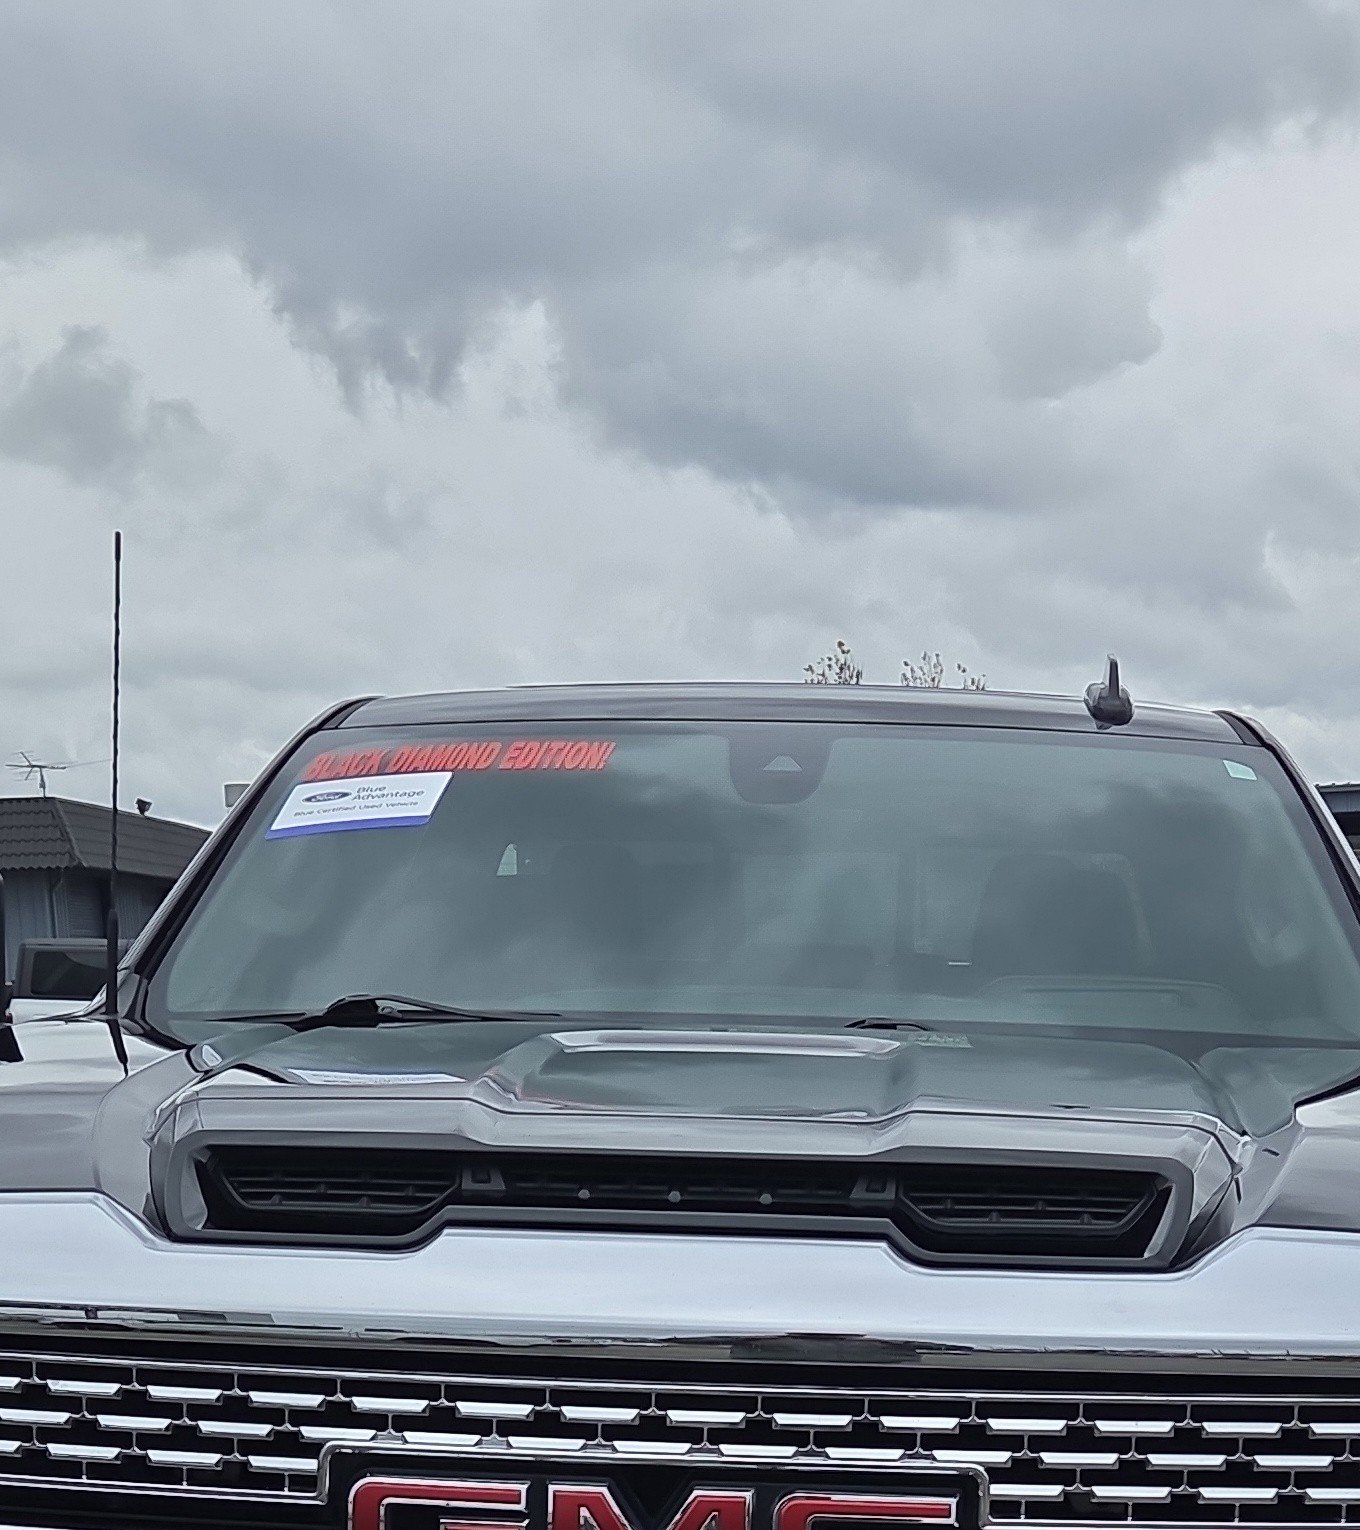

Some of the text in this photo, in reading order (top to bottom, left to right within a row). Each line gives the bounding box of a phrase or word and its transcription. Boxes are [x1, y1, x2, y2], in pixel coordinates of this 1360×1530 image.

[304, 741, 616, 780] BLACK DIAMOND EDITION!
[356, 786, 387, 794] Blue
[351, 790, 426, 801] Advantage
[316, 805, 357, 815] Certified
